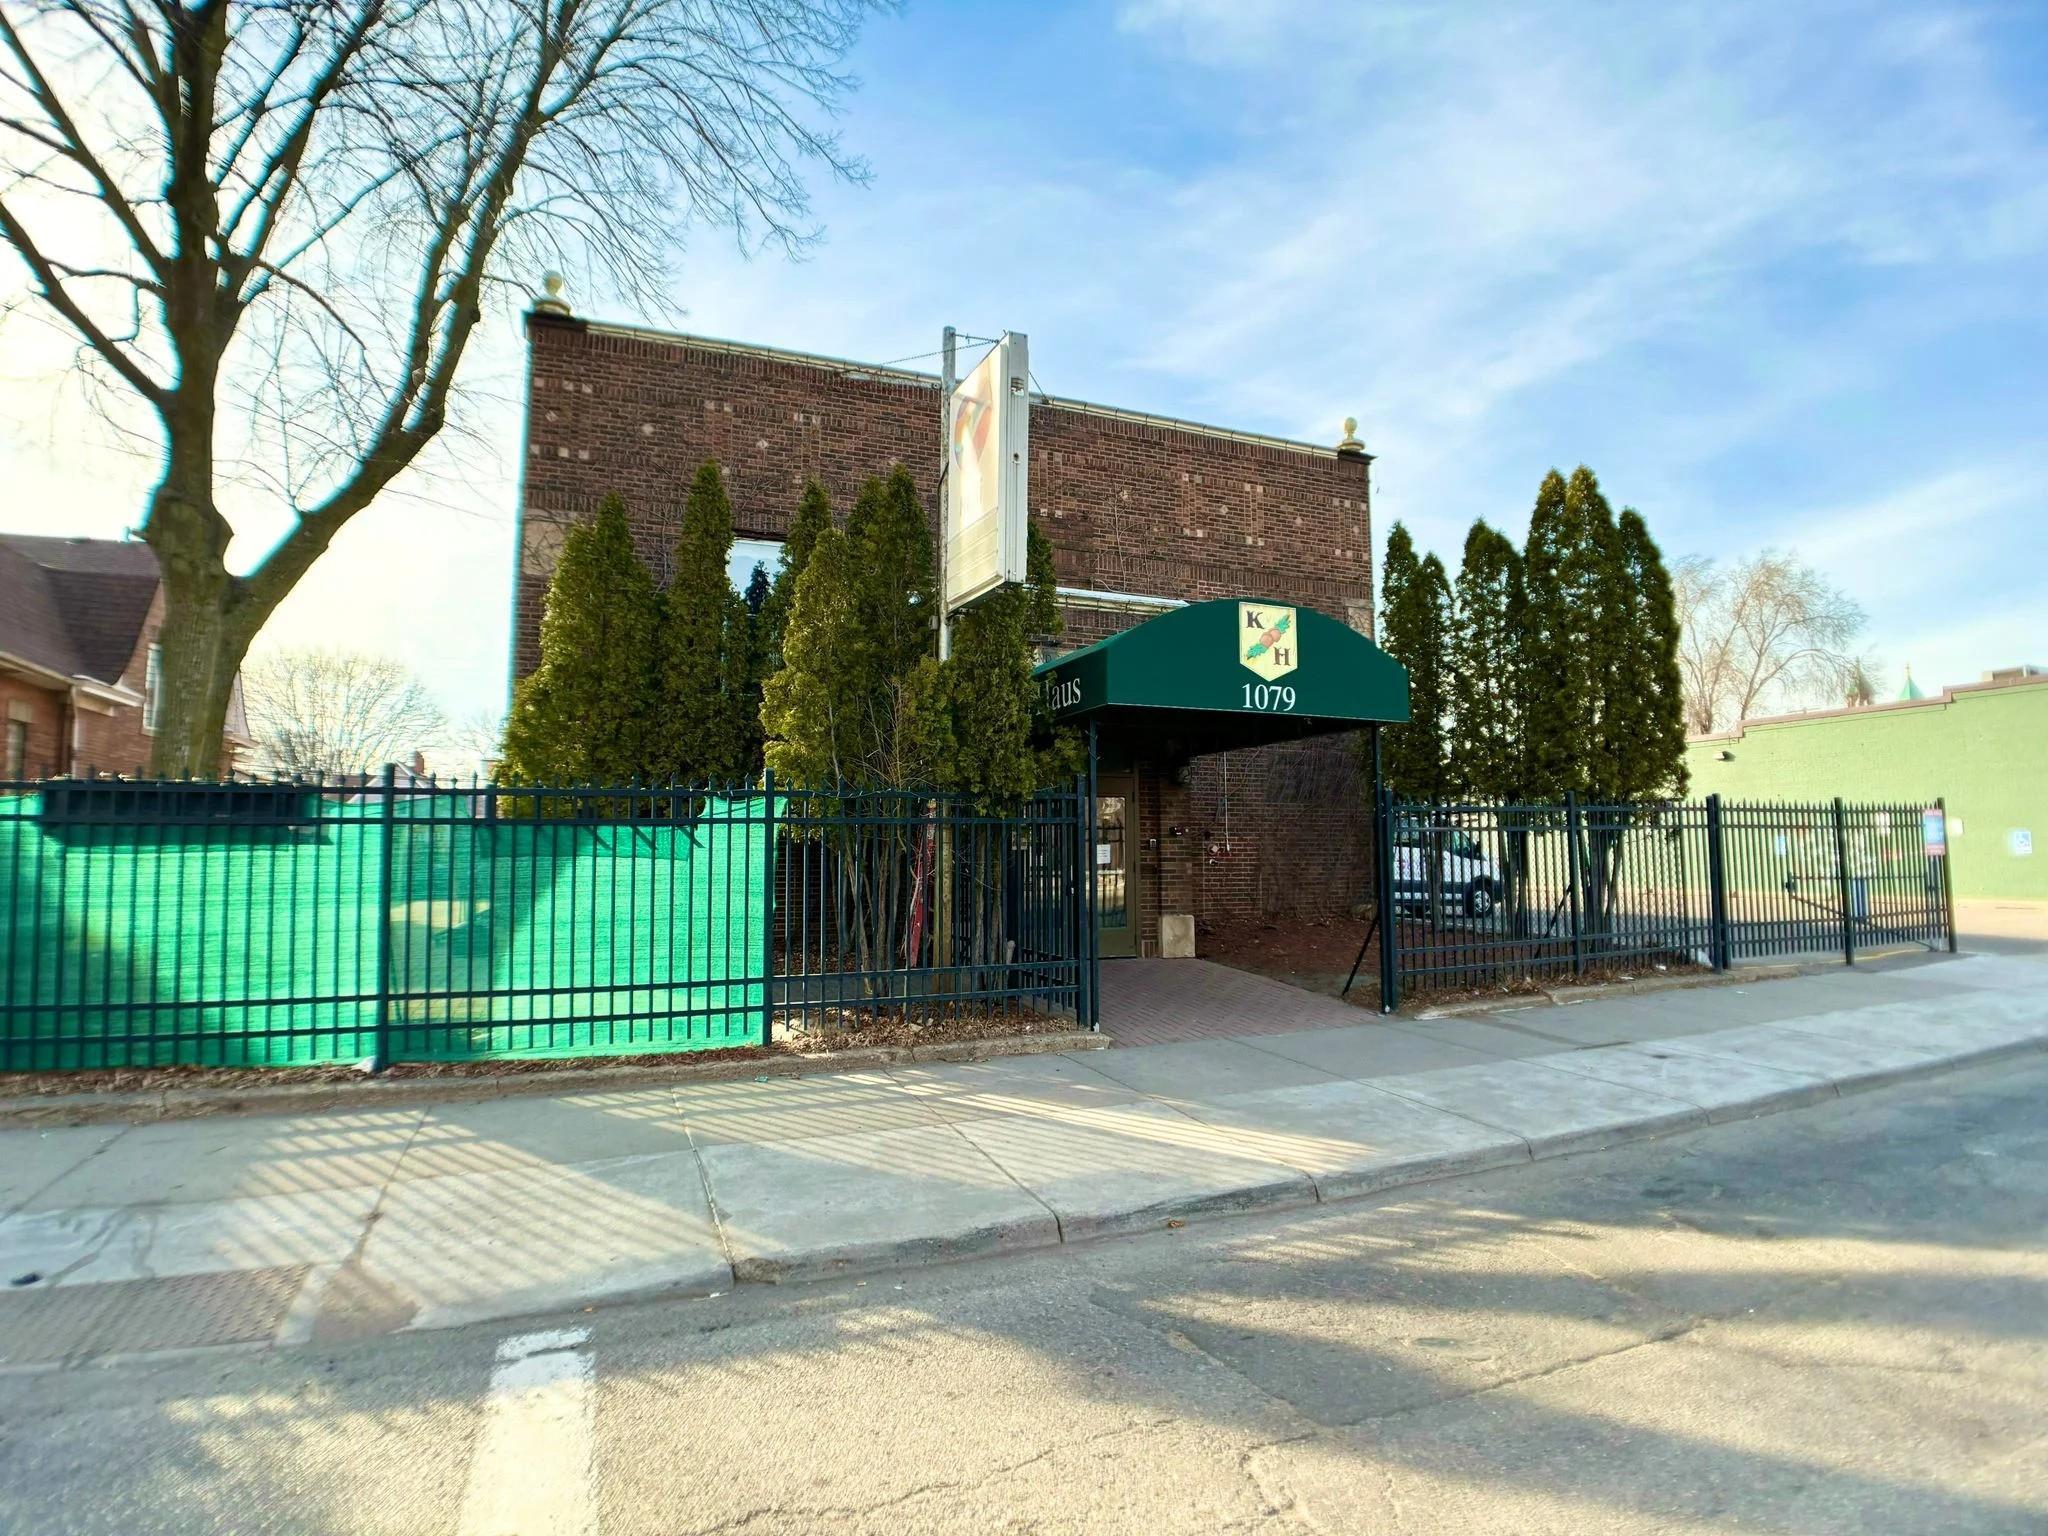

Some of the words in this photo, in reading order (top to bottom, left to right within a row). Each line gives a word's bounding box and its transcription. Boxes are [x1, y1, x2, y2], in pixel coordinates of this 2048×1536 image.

[1246, 610, 1265, 630] K
[1273, 646, 1291, 666] H
[1242, 683, 1296, 711] 1079
